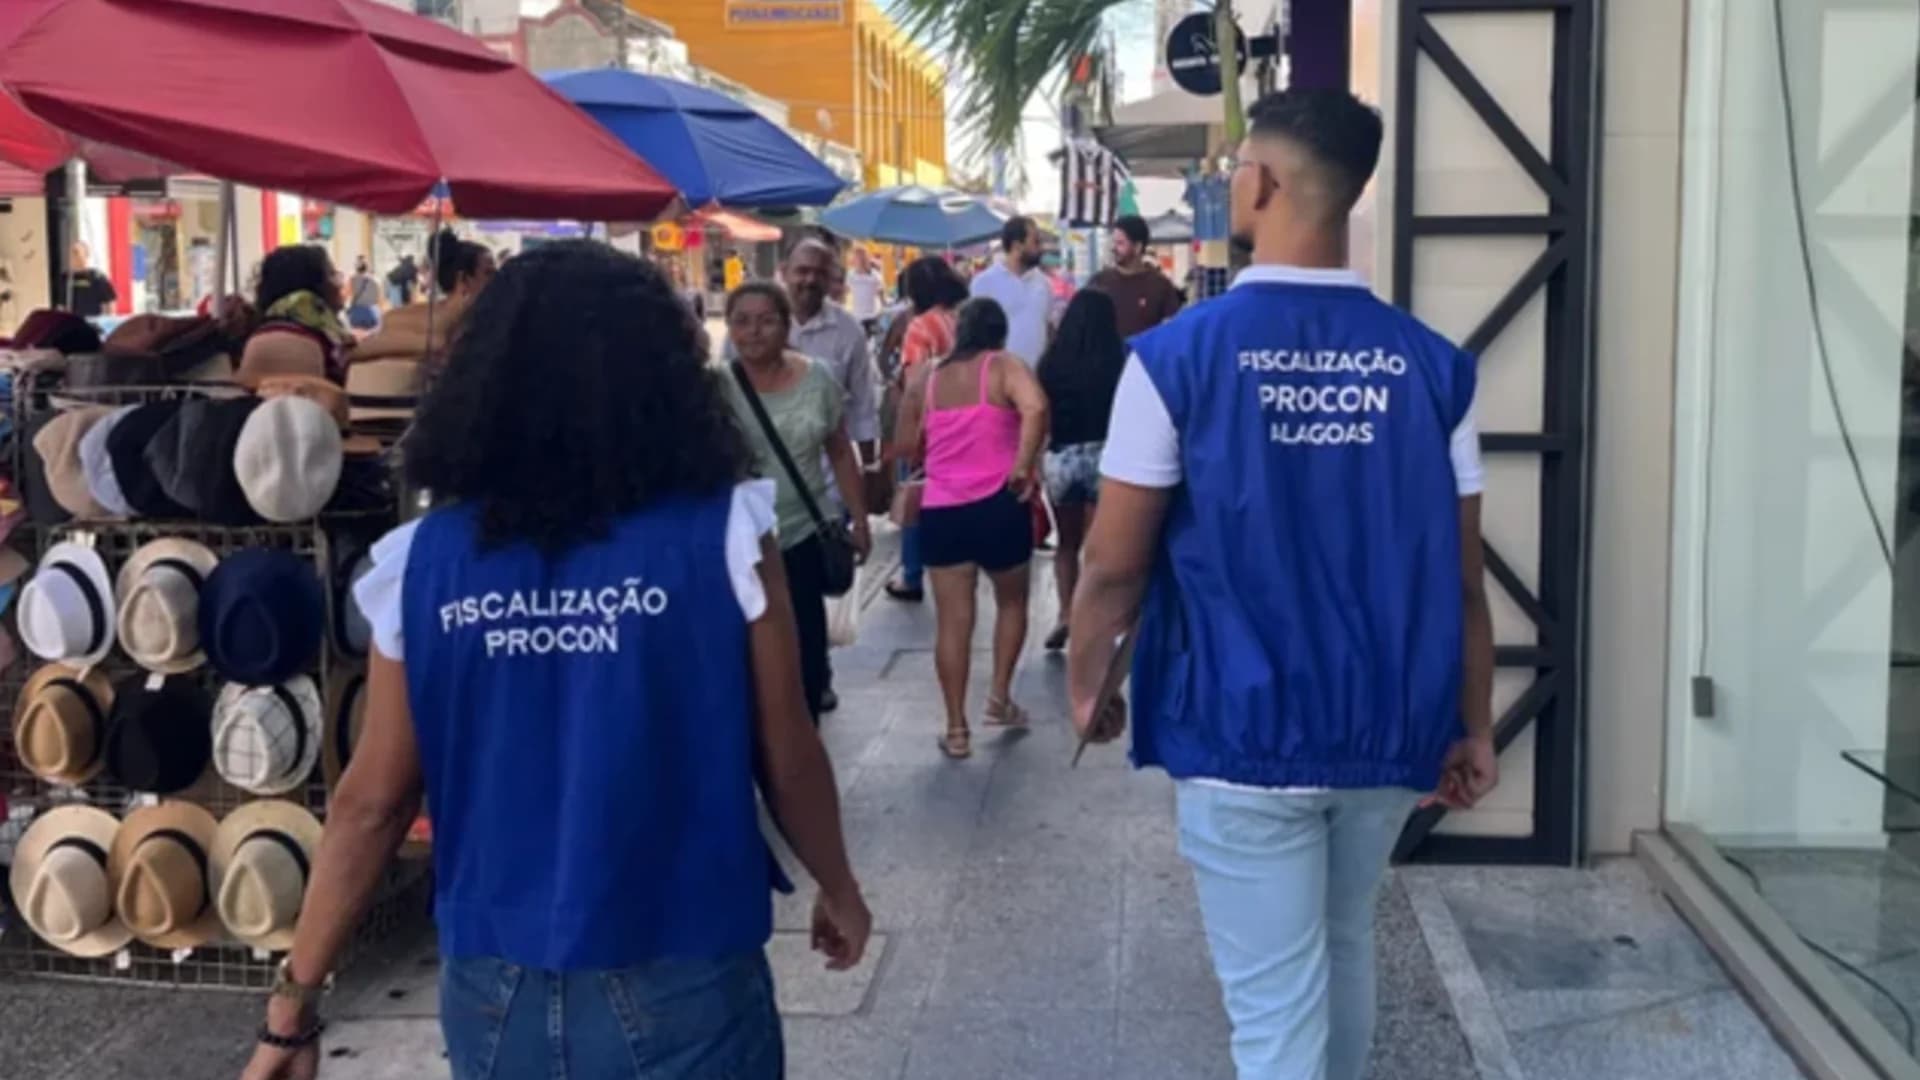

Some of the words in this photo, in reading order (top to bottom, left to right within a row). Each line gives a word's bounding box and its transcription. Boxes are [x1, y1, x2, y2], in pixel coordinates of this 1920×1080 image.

[1238, 348, 1407, 377] FISCALIZAÇÃO
[1259, 385, 1388, 413] PROCON
[1271, 422, 1375, 445] ALAGOAS
[439, 577, 668, 633] FISCALIZAÇÃO
[484, 624, 619, 657] PROCON
